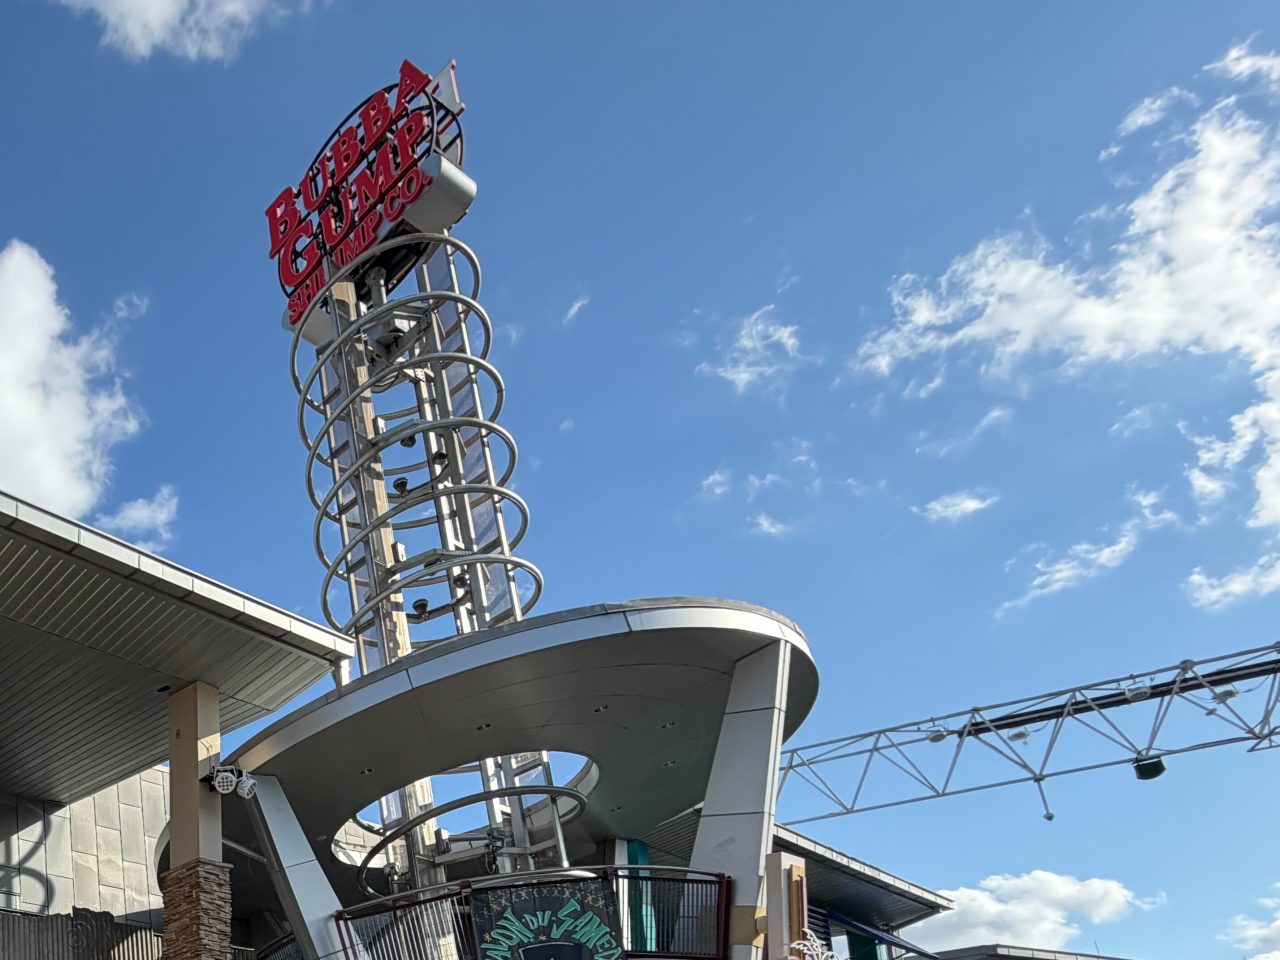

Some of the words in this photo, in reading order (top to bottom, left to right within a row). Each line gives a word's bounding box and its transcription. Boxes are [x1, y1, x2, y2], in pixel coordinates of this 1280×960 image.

[265, 58, 433, 259] BUBBA
[279, 111, 429, 288] GUMP
[525, 910, 552, 930] DU
